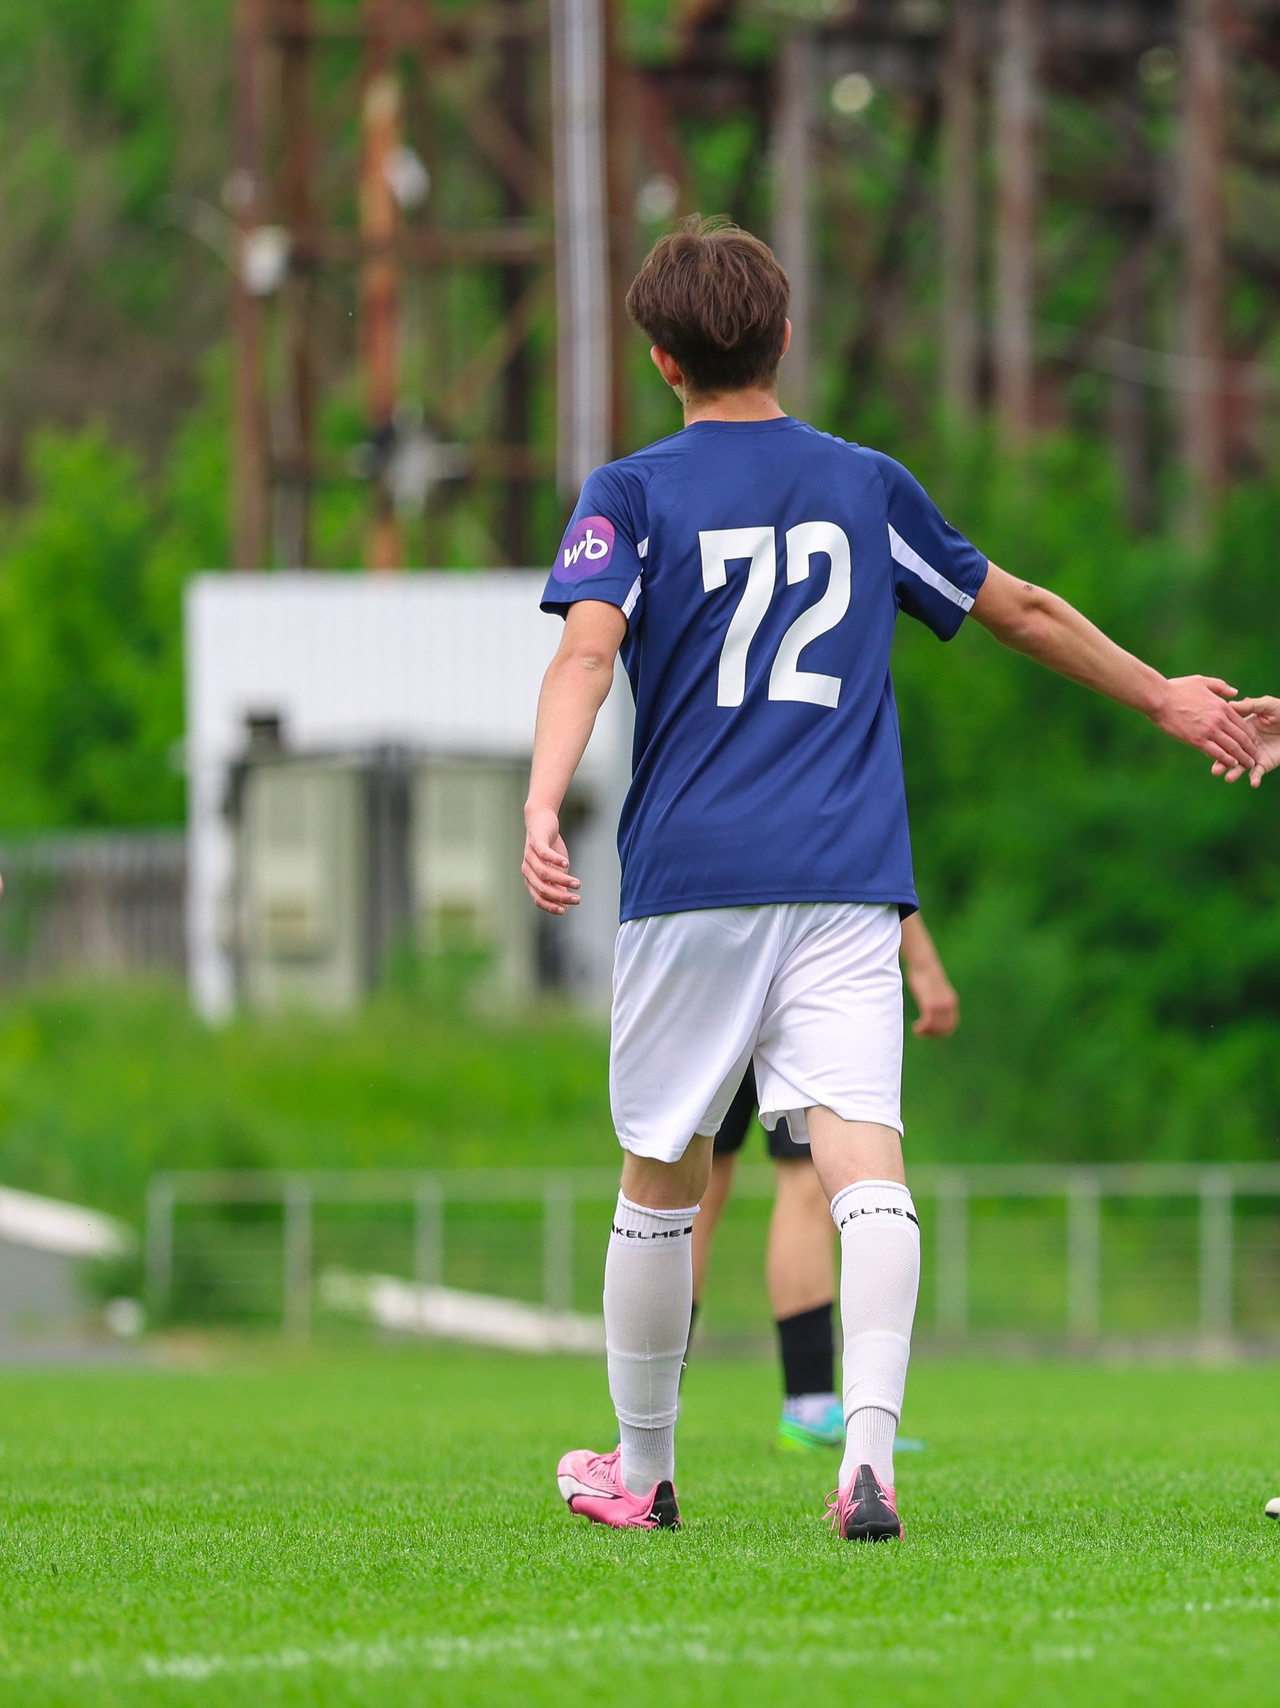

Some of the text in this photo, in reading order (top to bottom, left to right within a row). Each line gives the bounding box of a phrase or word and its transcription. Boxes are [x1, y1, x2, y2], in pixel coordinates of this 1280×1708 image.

[563, 529, 608, 568] wb
[699, 521, 851, 709] 72
[616, 1227, 681, 1239] KELME
[840, 1207, 904, 1229] KELME
